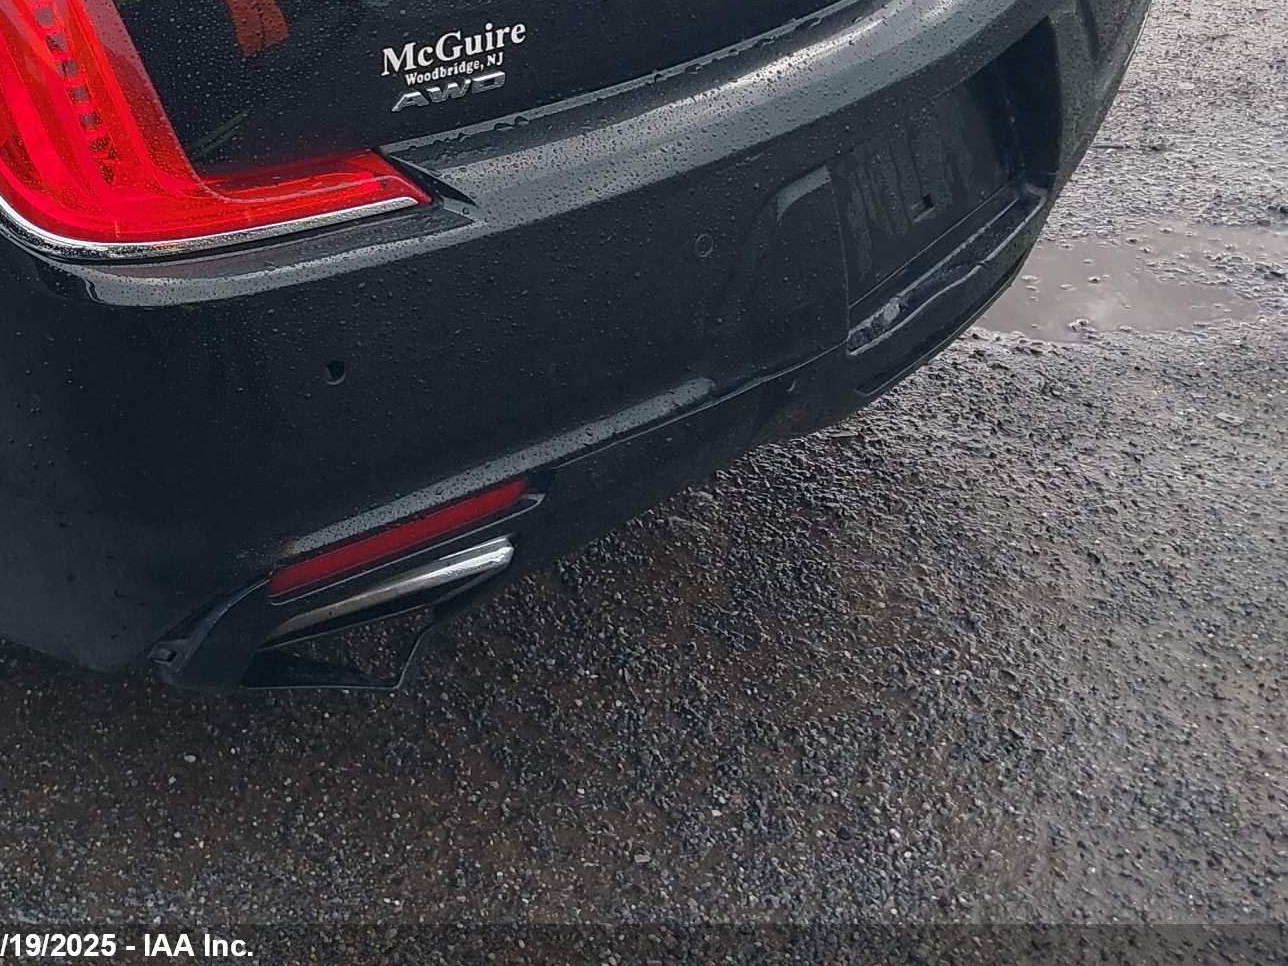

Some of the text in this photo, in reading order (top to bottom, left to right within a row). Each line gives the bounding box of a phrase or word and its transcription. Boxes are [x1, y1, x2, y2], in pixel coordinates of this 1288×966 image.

[381, 22, 526, 76] McGuire
[405, 52, 504, 86] Woodbridge, NJ
[392, 71, 506, 112] AWD
